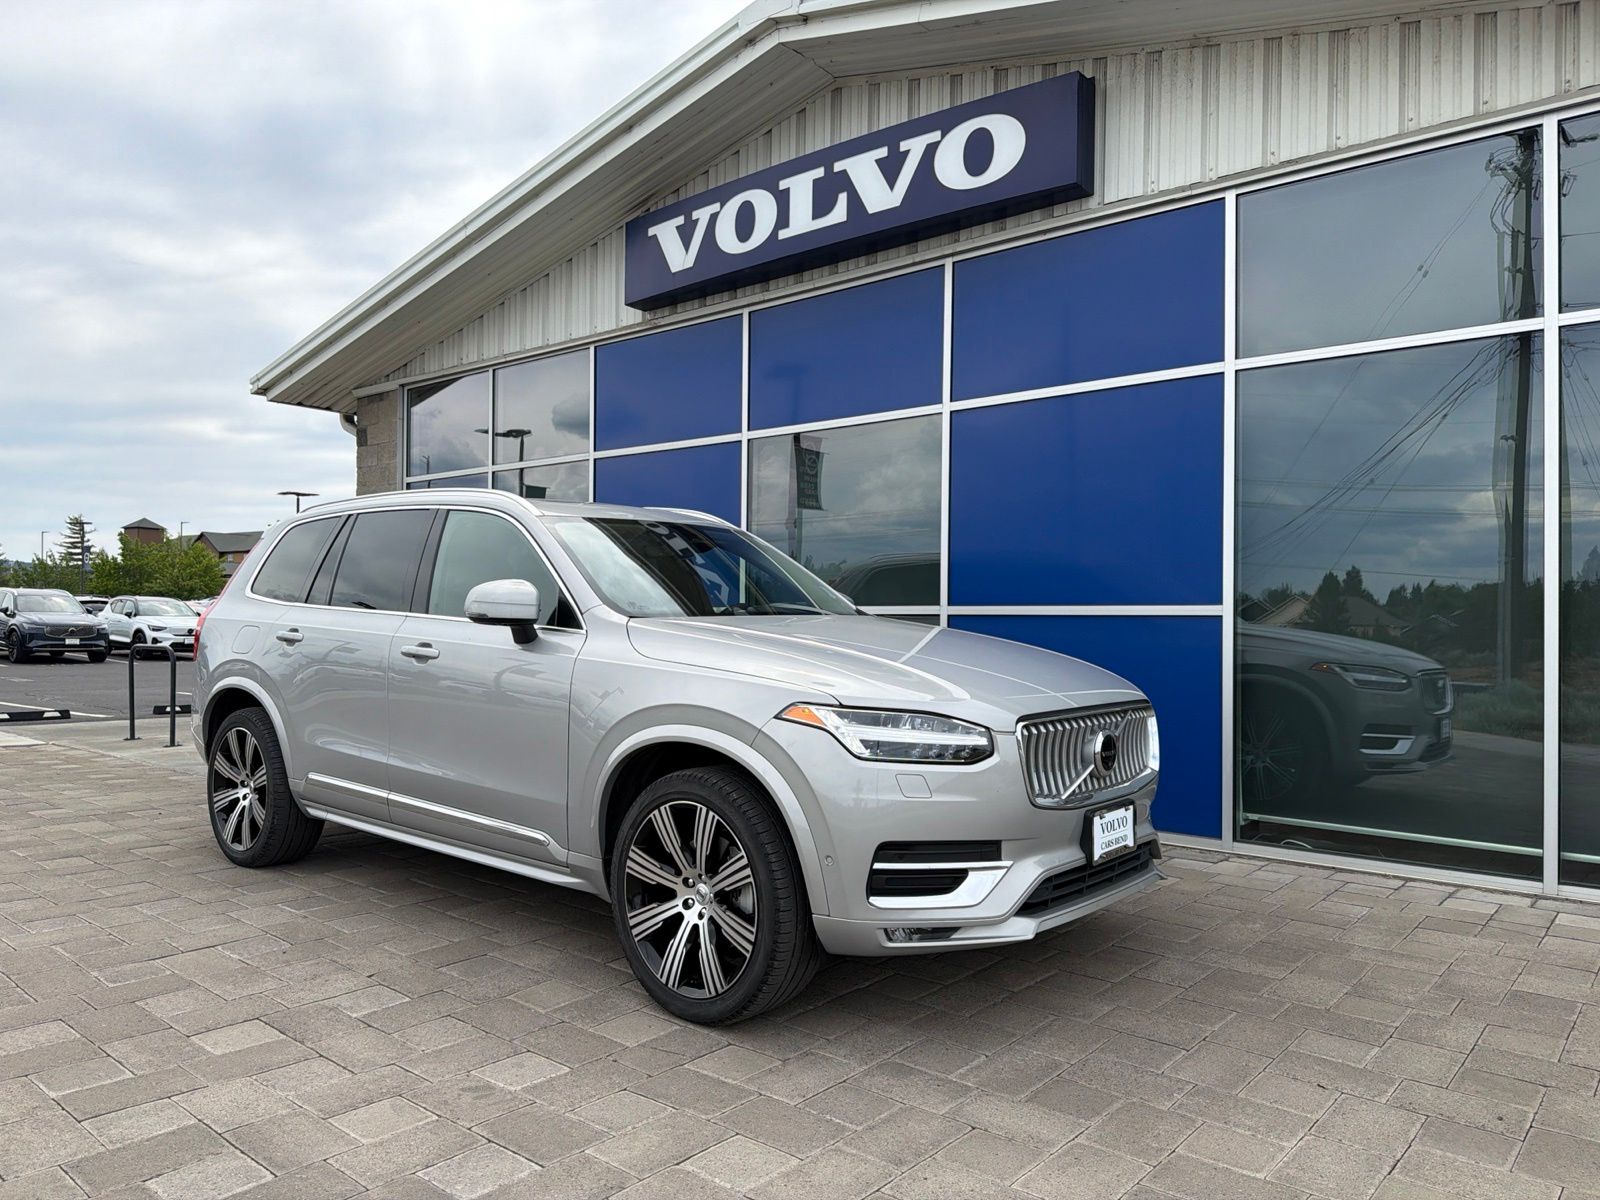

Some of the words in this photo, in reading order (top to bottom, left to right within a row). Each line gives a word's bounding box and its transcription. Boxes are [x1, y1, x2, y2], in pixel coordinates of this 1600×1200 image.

[648, 113, 1026, 274] VOLVO
[1100, 816, 1128, 835] VOLVO
[1100, 839, 1114, 850] CARS
